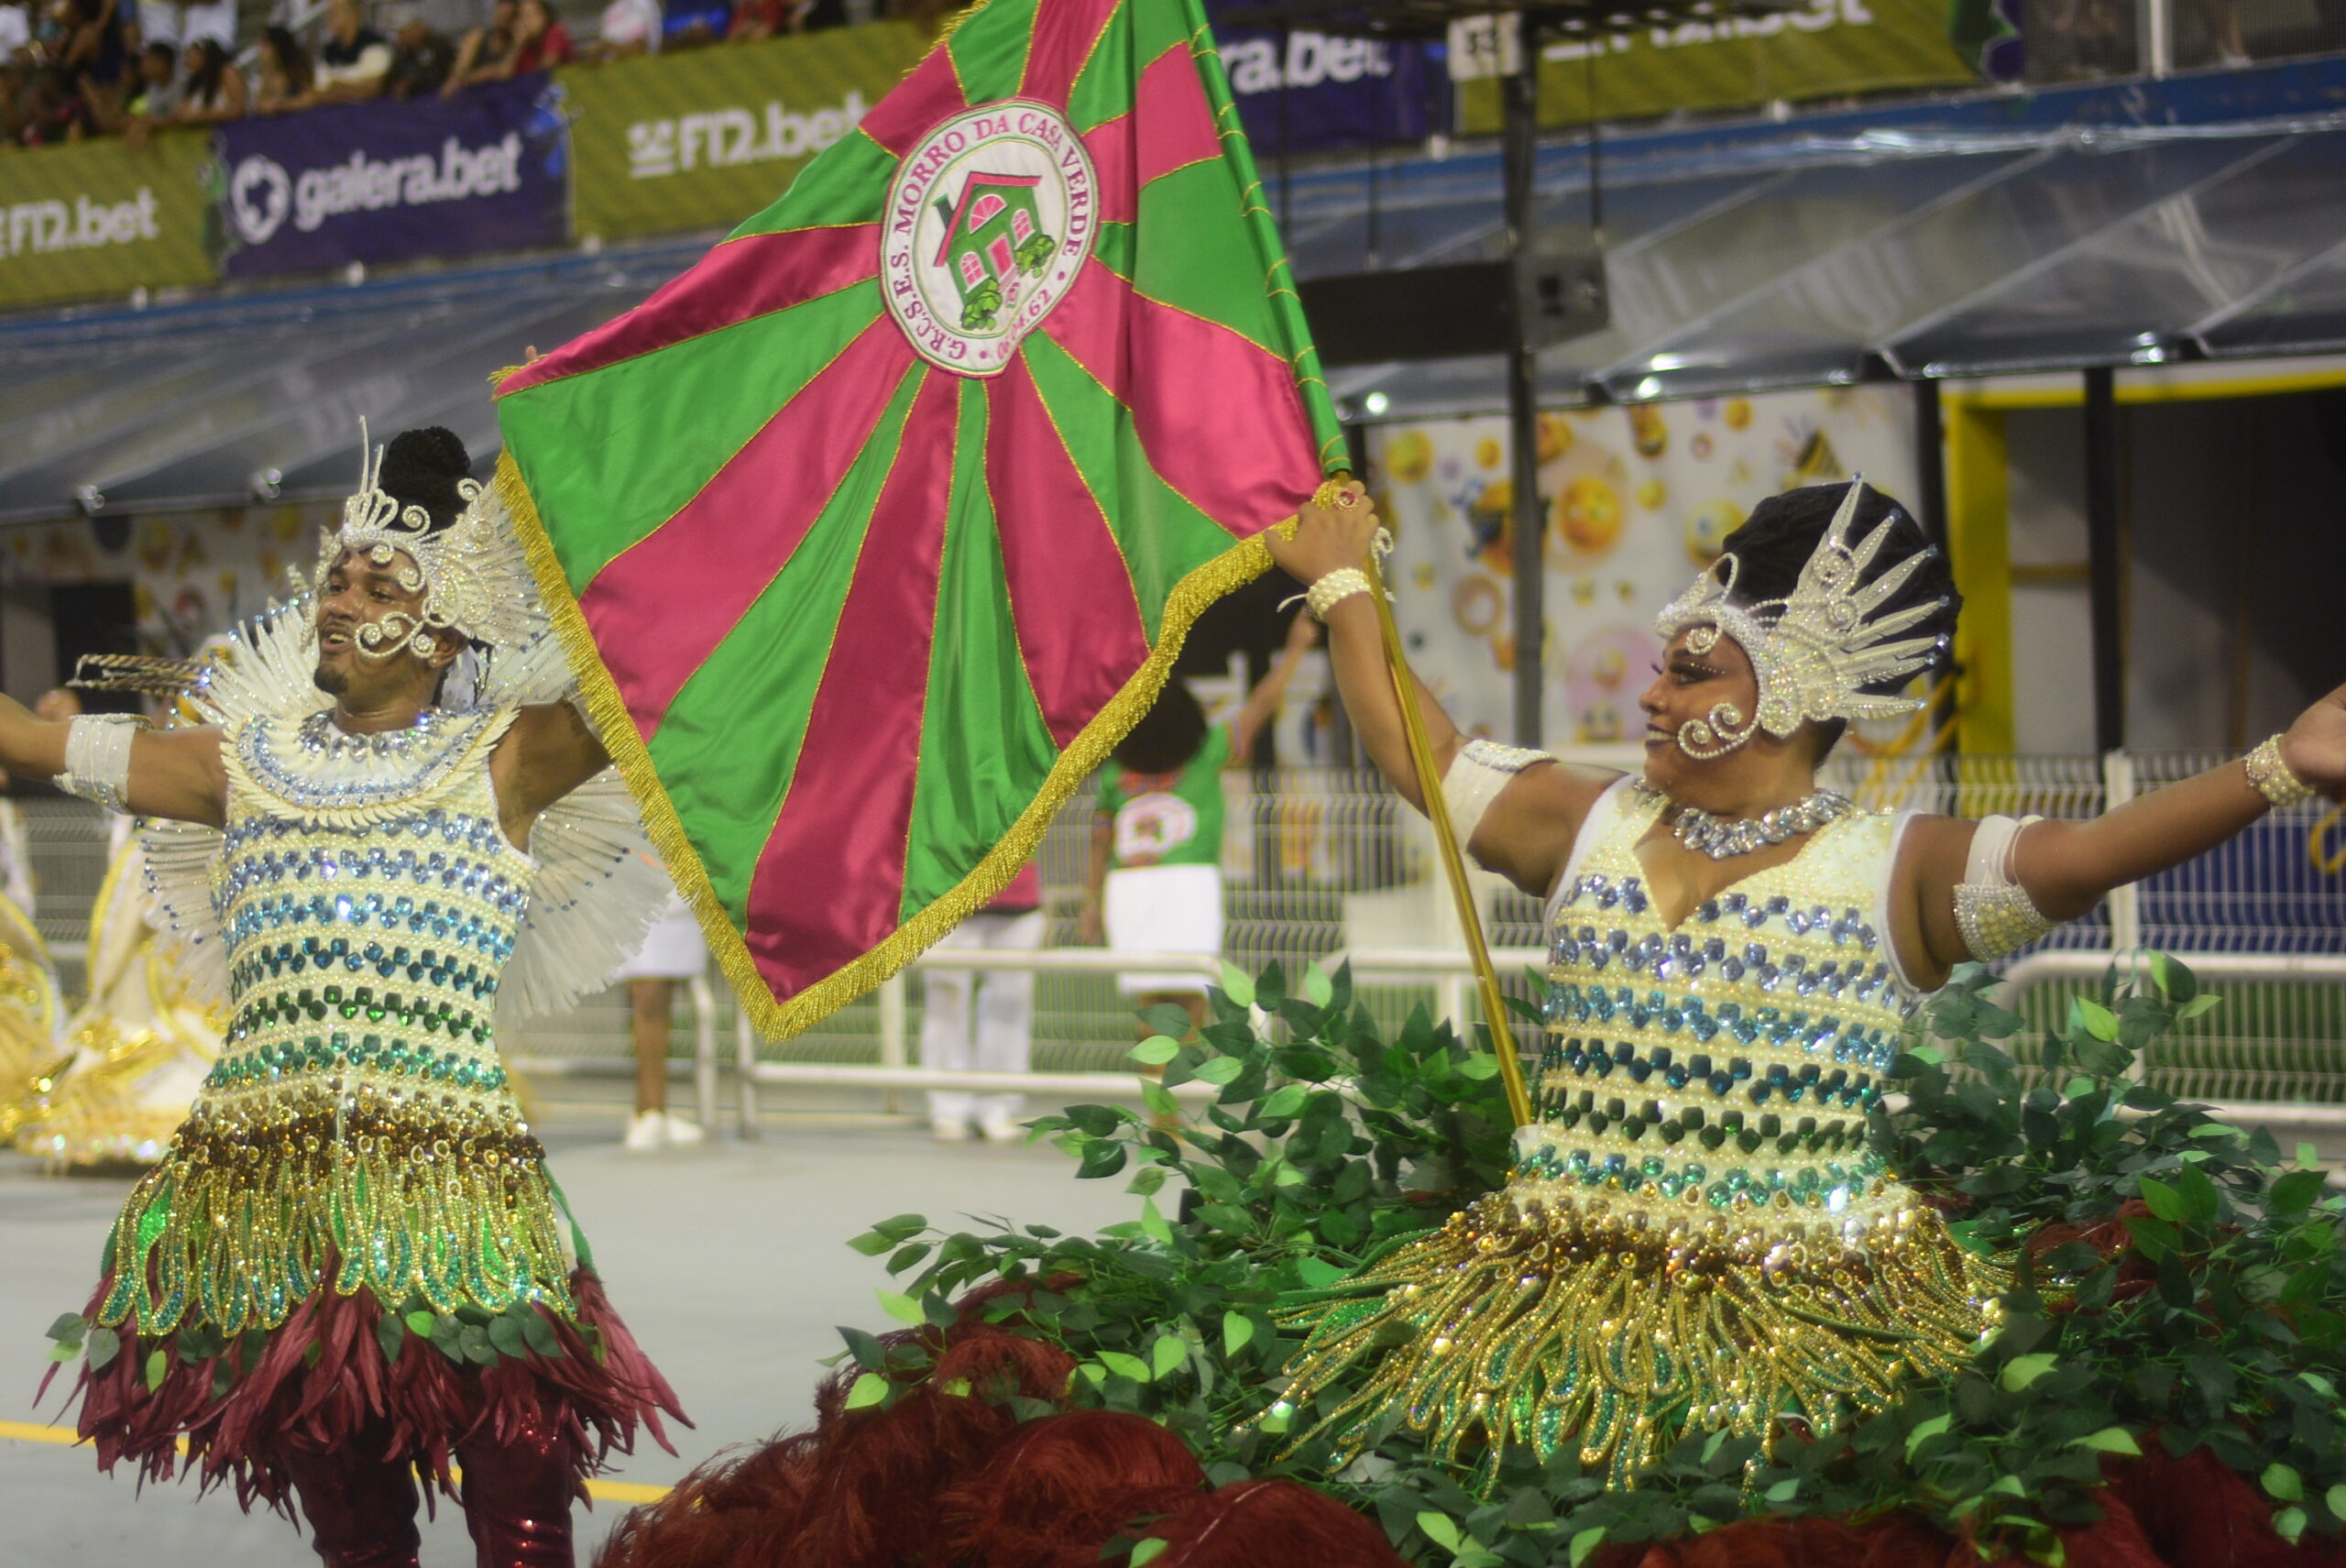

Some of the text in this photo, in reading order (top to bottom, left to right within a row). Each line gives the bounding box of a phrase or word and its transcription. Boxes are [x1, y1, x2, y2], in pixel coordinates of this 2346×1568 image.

[295, 132, 522, 232] galera.bet
[893, 130, 967, 236] MORRO
[972, 114, 1011, 141] DA
[1018, 112, 1064, 153] CASA
[1060, 145, 1090, 256] VERDE
